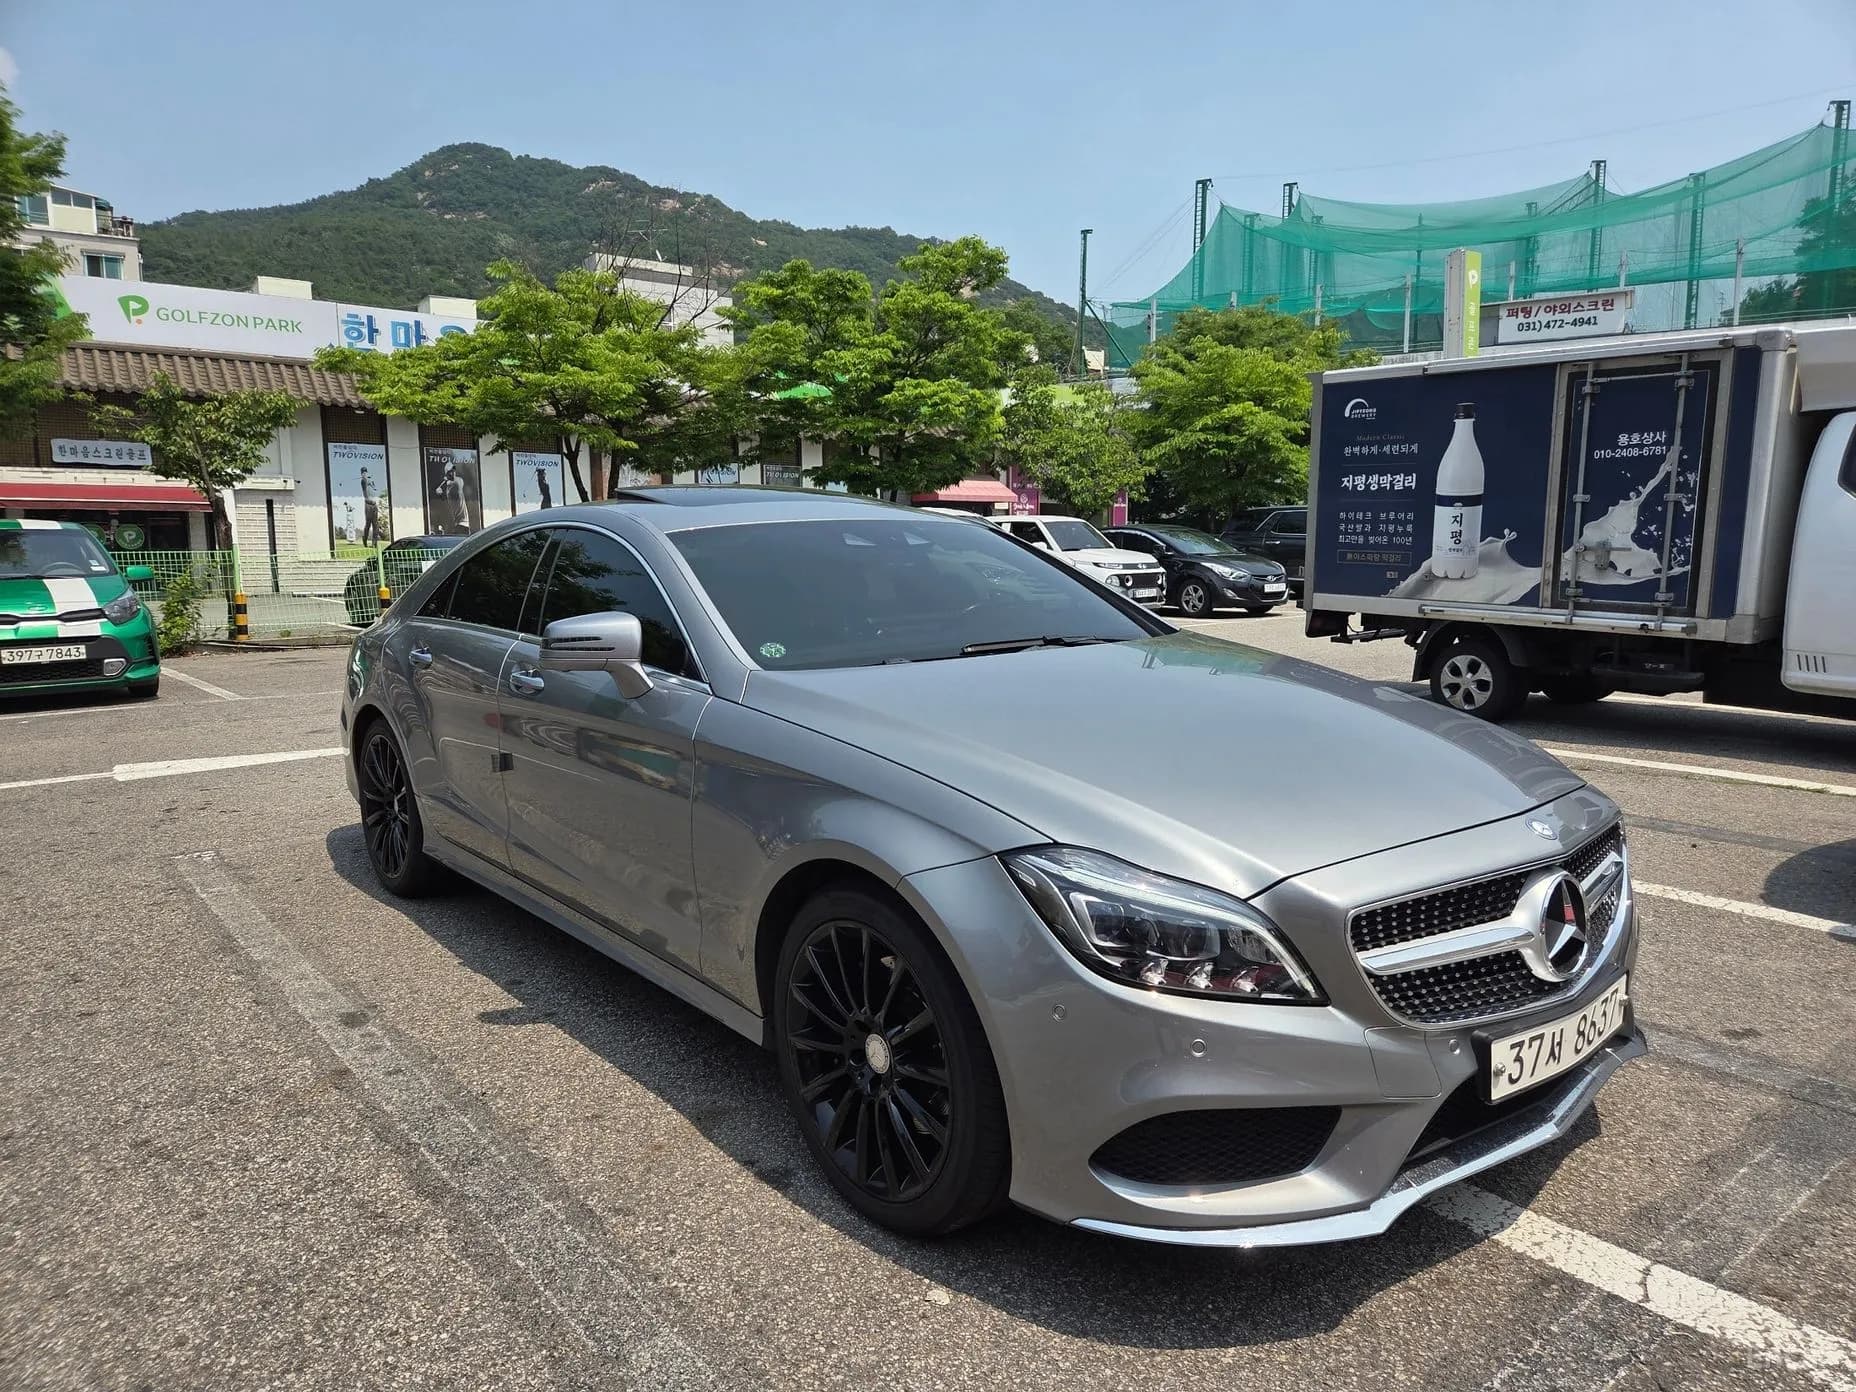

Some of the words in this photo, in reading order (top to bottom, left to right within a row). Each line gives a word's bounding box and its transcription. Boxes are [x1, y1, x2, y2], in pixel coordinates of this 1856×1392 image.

[156, 307, 249, 328] GOLFZON
[253, 317, 303, 333] PARK
[1517, 316, 1598, 332] 031)472-4941
[341, 313, 467, 352] 한마
[1617, 431, 1667, 446] 용호상사
[58, 445, 147, 461] 한마음스크린골프
[333, 451, 384, 460] TWOVISION
[1594, 446, 1666, 459] 010-2408-6781
[516, 459, 560, 467] TWOVISION
[1341, 473, 1416, 491] 지평생막걸리
[1339, 511, 1372, 520] 하이테크
[1379, 511, 1414, 520] 브루어리
[1450, 512, 1463, 545] 지평
[1392, 536, 1412, 546] 100년
[46, 646, 81, 659] 7843
[1507, 1027, 1564, 1085] 37서
[1574, 987, 1619, 1055] 8637
